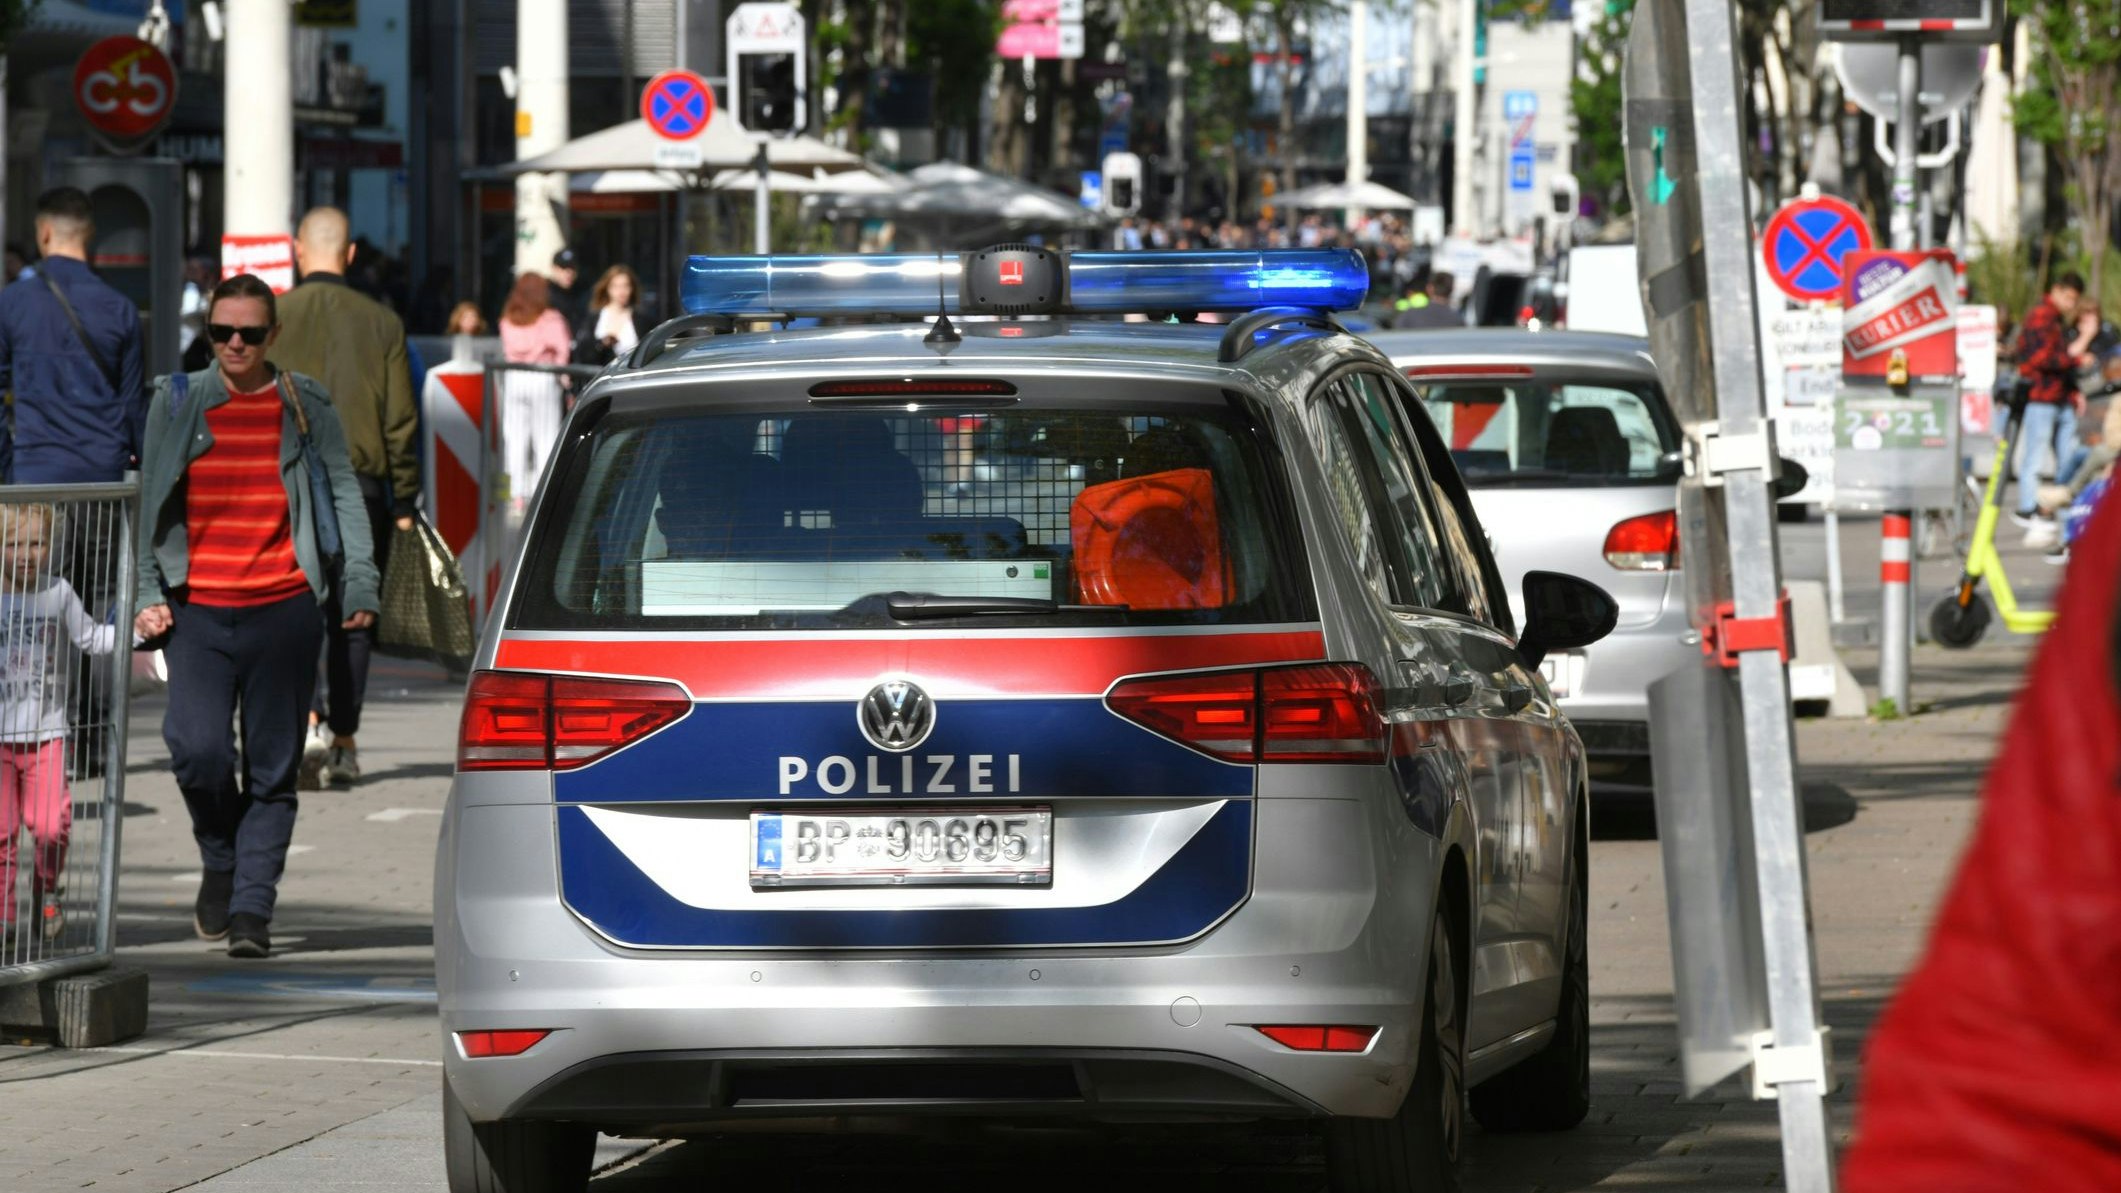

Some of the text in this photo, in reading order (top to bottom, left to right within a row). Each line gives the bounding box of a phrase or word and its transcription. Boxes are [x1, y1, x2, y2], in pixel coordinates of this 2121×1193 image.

[1851, 296, 1941, 348] KURIER
[865, 684, 928, 743] VW
[778, 754, 1020, 795] POLIZEI
[763, 849, 776, 863] A
[797, 819, 851, 863] BP
